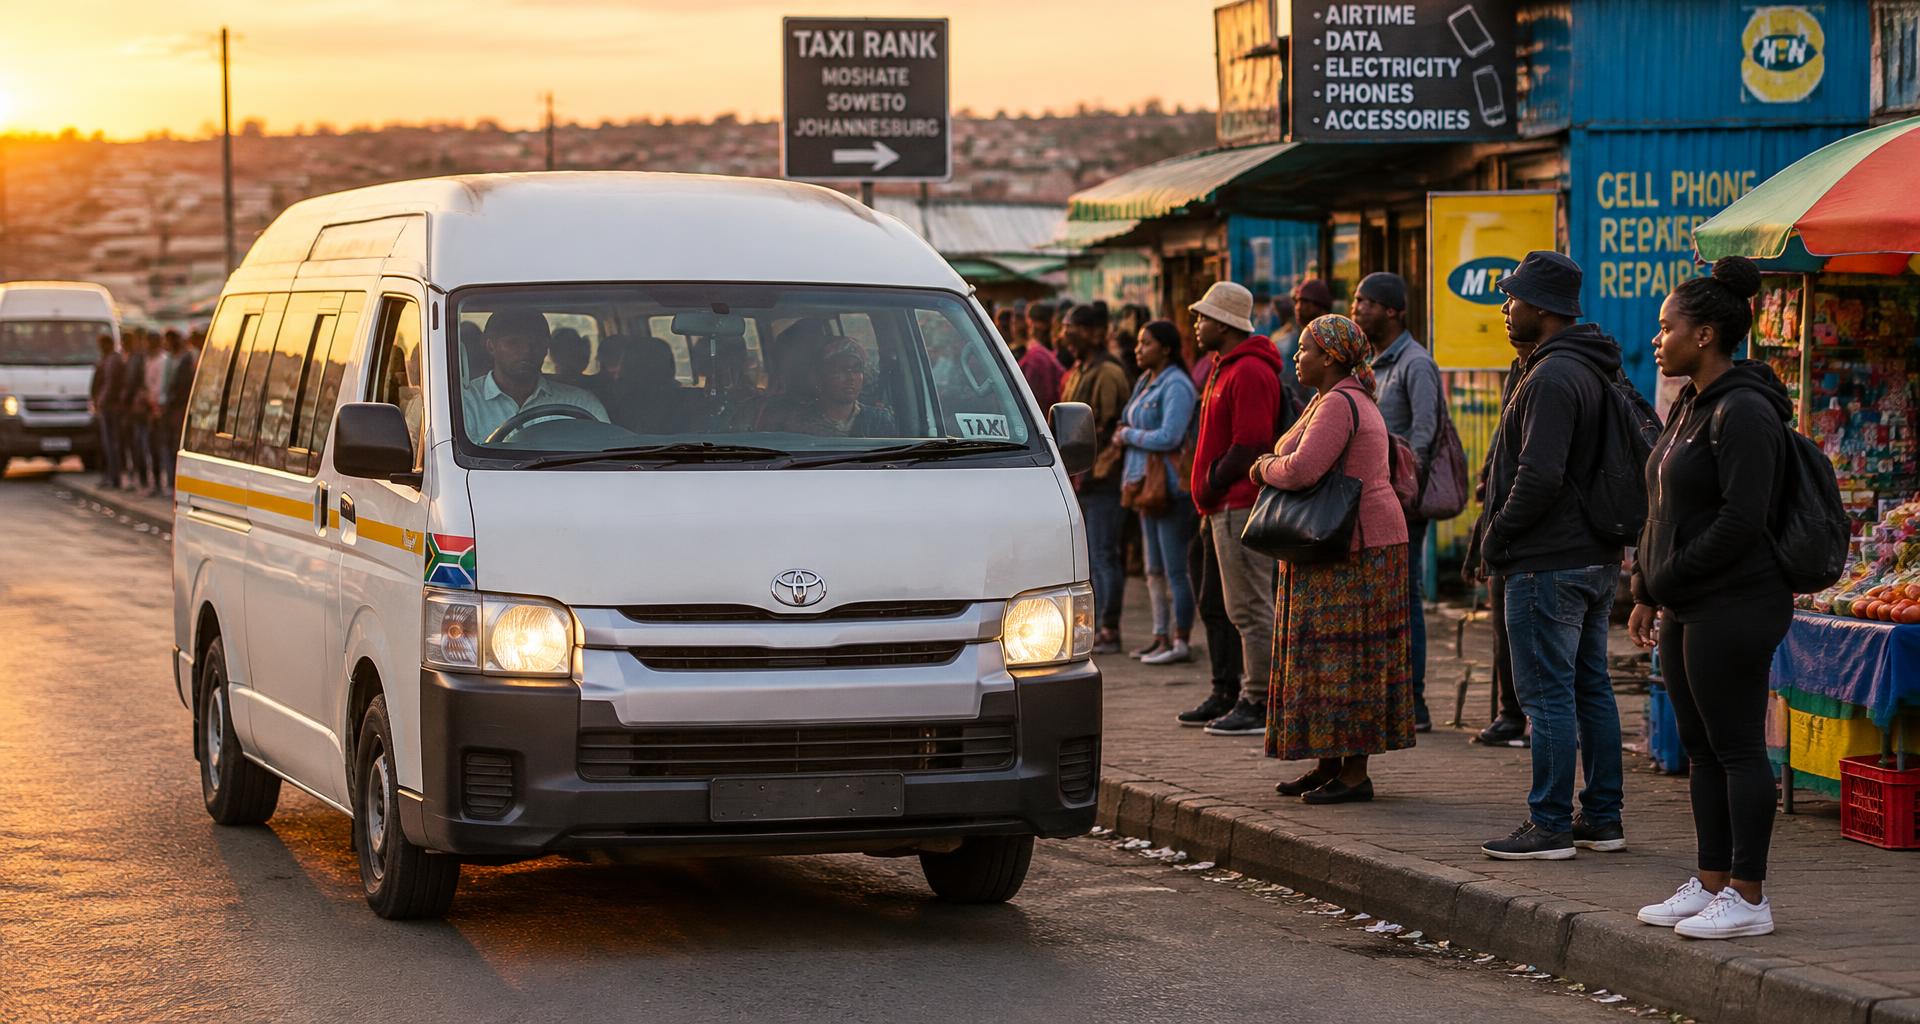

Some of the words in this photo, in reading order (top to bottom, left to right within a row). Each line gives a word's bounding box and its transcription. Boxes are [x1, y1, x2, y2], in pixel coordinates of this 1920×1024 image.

[1325, 5, 1415, 25] AIRTIME
[793, 30, 855, 58] TAXI
[863, 30, 937, 58] RANK
[1325, 31, 1383, 51] DATA
[822, 67, 909, 86] MOSHATE
[1325, 57, 1462, 77] ELECTRICITY
[827, 93, 906, 111] SOWETO
[1325, 83, 1414, 103] PHONES
[795, 118, 939, 137] JOHANNESBURG
[1324, 110, 1470, 130] ACCESSORIES
[1597, 171, 1659, 208] CELL
[962, 418, 1008, 437] TAXI
